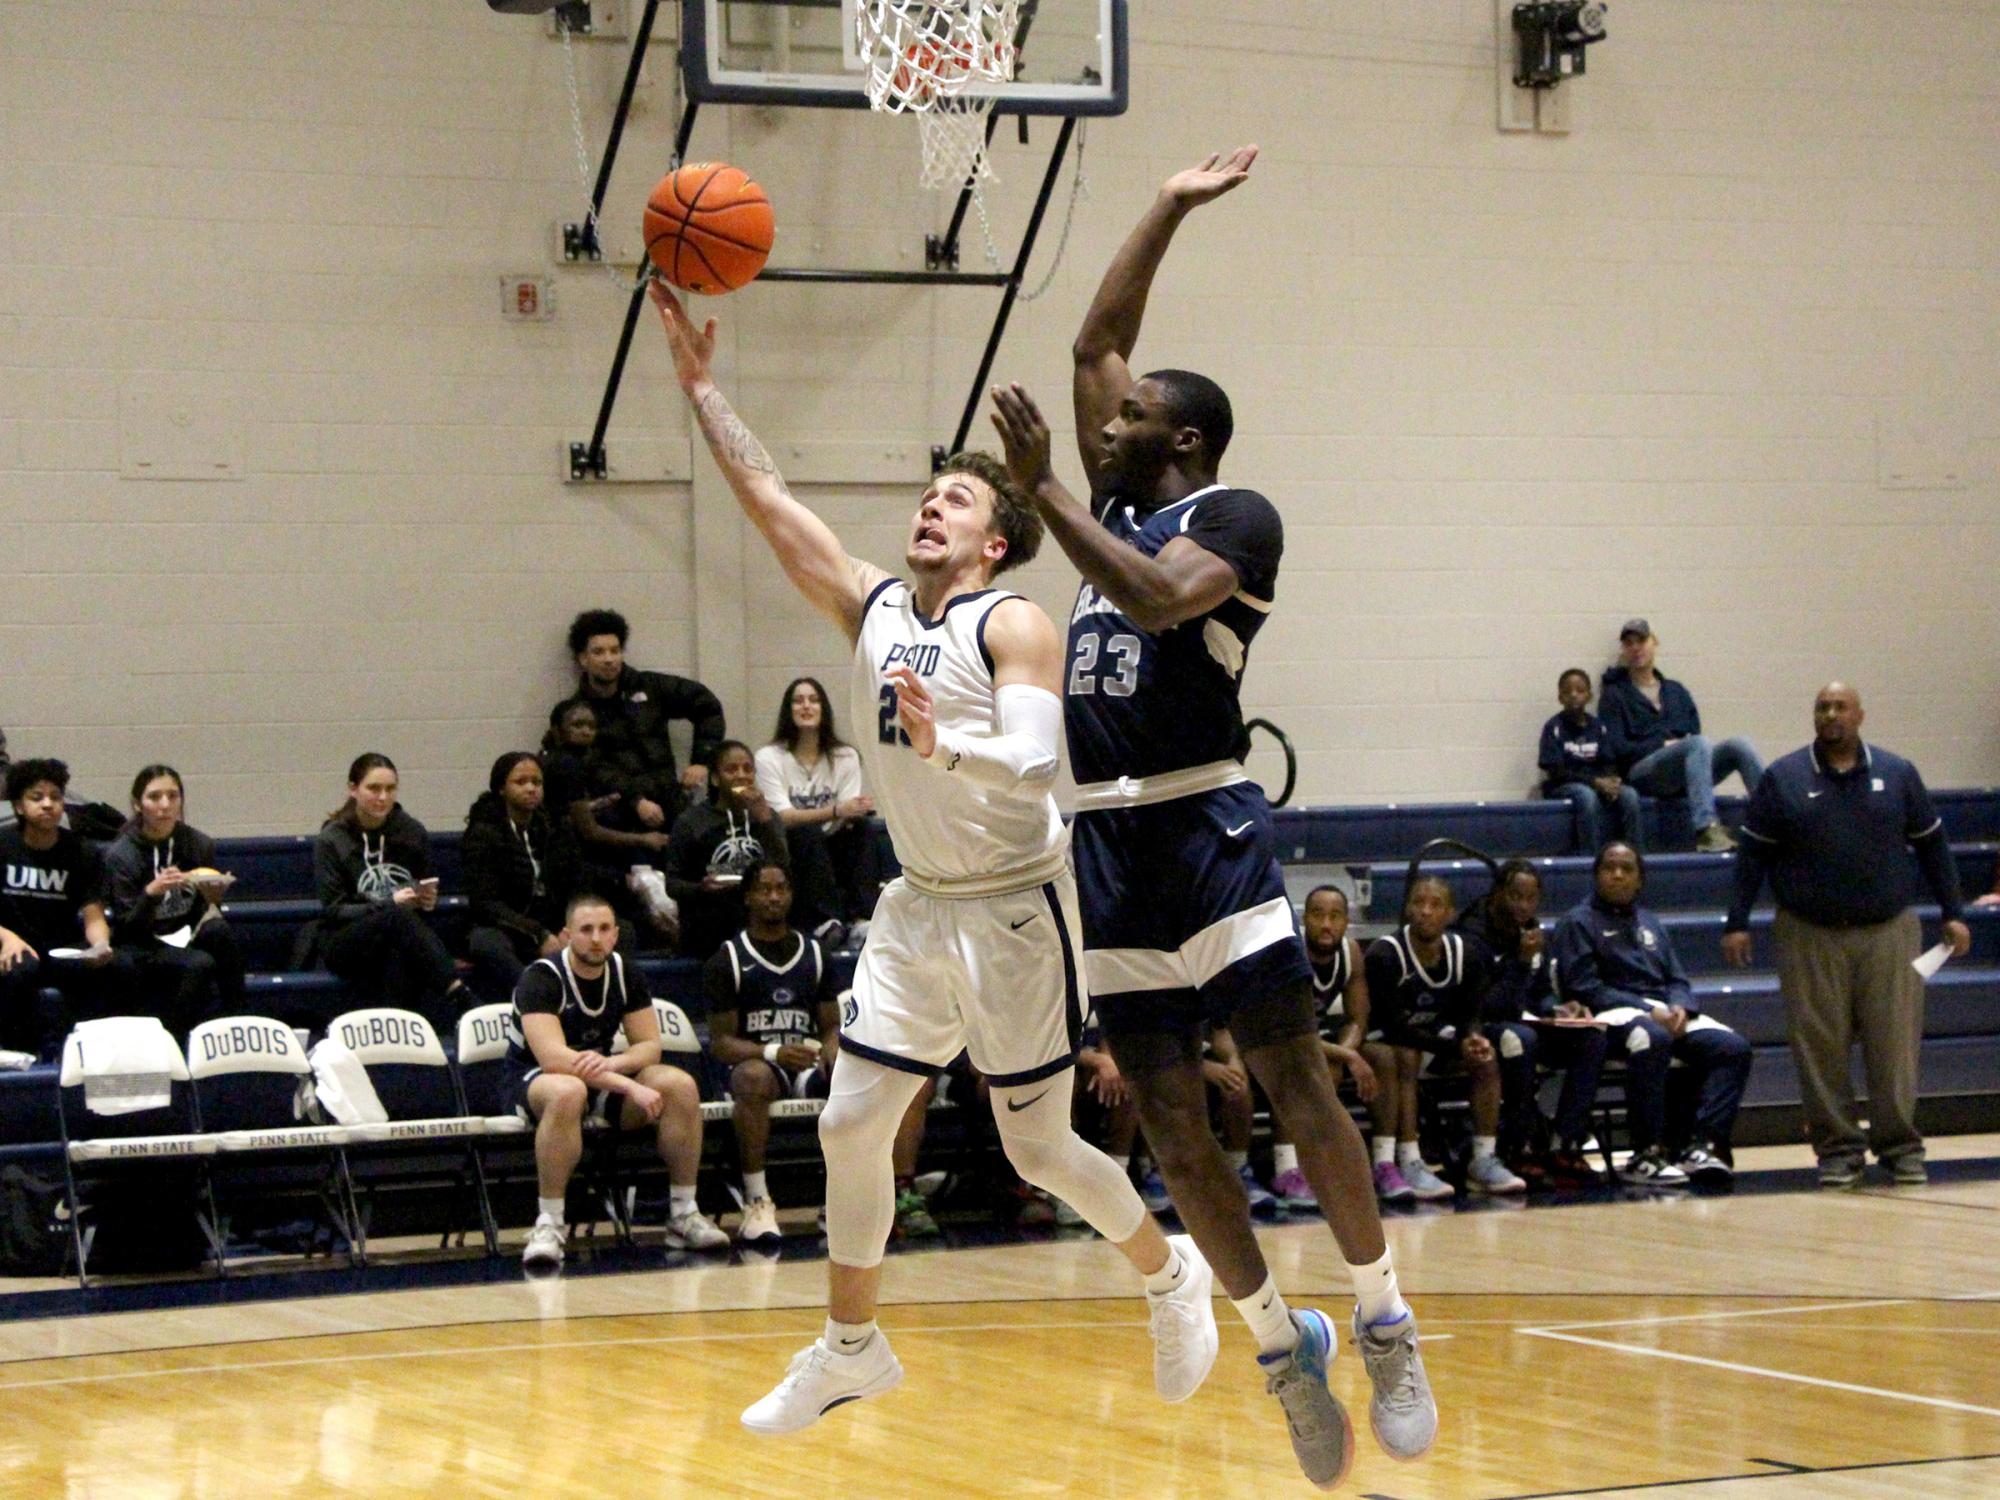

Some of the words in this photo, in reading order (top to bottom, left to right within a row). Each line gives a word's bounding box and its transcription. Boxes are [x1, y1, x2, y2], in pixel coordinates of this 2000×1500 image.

[1069, 632, 1142, 697] 23
[878, 683, 913, 746] 2
[6, 864, 70, 892] UIW
[342, 1018, 425, 1050] DuBOIS
[746, 1009, 818, 1034] BEAVER
[202, 1026, 288, 1060] DuBOIS
[782, 1102, 814, 1114] PENN
[250, 1135, 286, 1147] PENN
[291, 1133, 330, 1144] STATE
[391, 1125, 425, 1137] PENN
[429, 1122, 468, 1134] STATE
[110, 1143, 147, 1155] PENN
[152, 1141, 195, 1153] STATE
